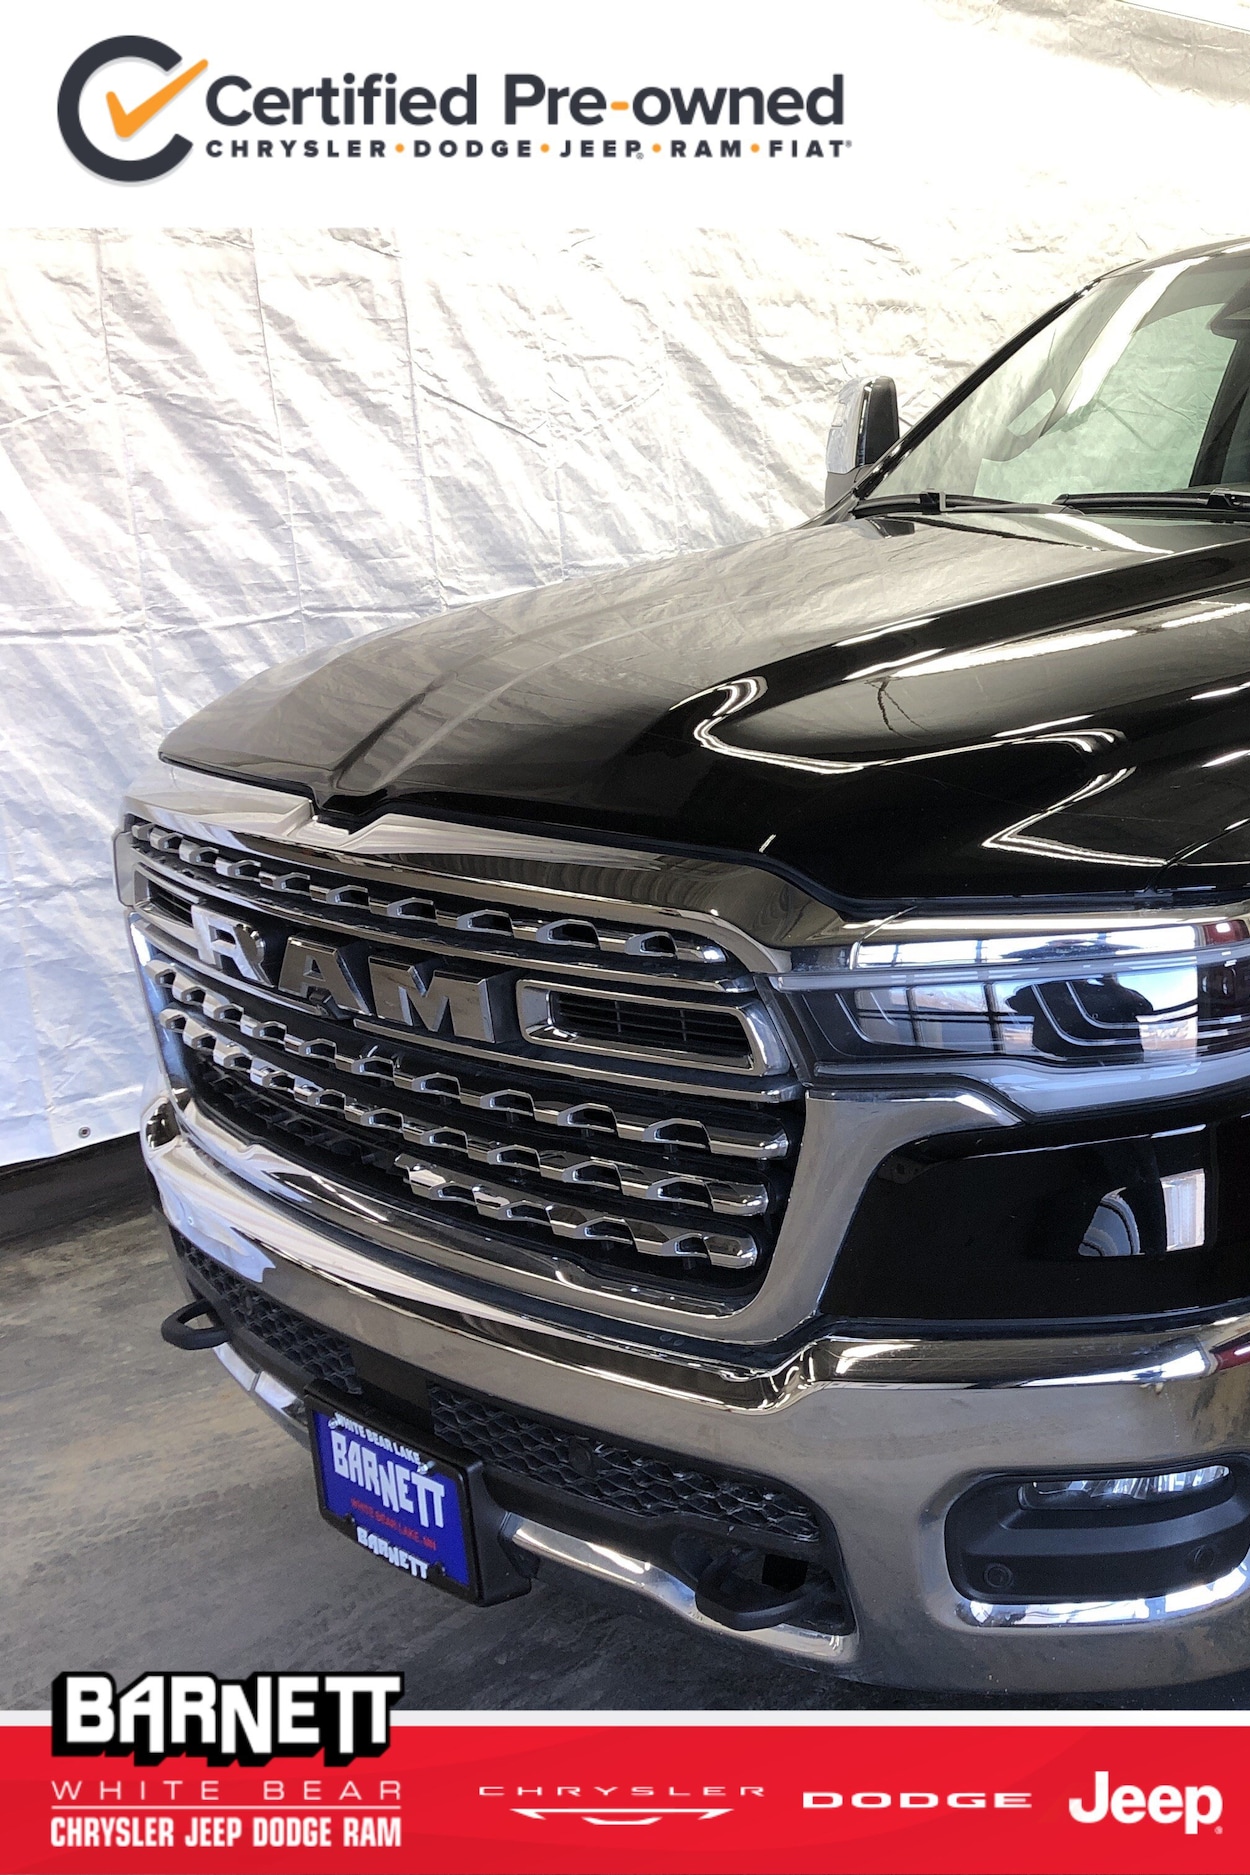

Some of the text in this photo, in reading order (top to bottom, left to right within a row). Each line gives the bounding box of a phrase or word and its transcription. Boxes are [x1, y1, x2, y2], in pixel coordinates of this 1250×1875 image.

[191, 904, 495, 1043] RAM
[331, 1430, 445, 1528] BARNETT
[365, 1428, 393, 1453] BEAR
[393, 1442, 421, 1465] LAKE
[356, 1526, 429, 1580] BARNETT
